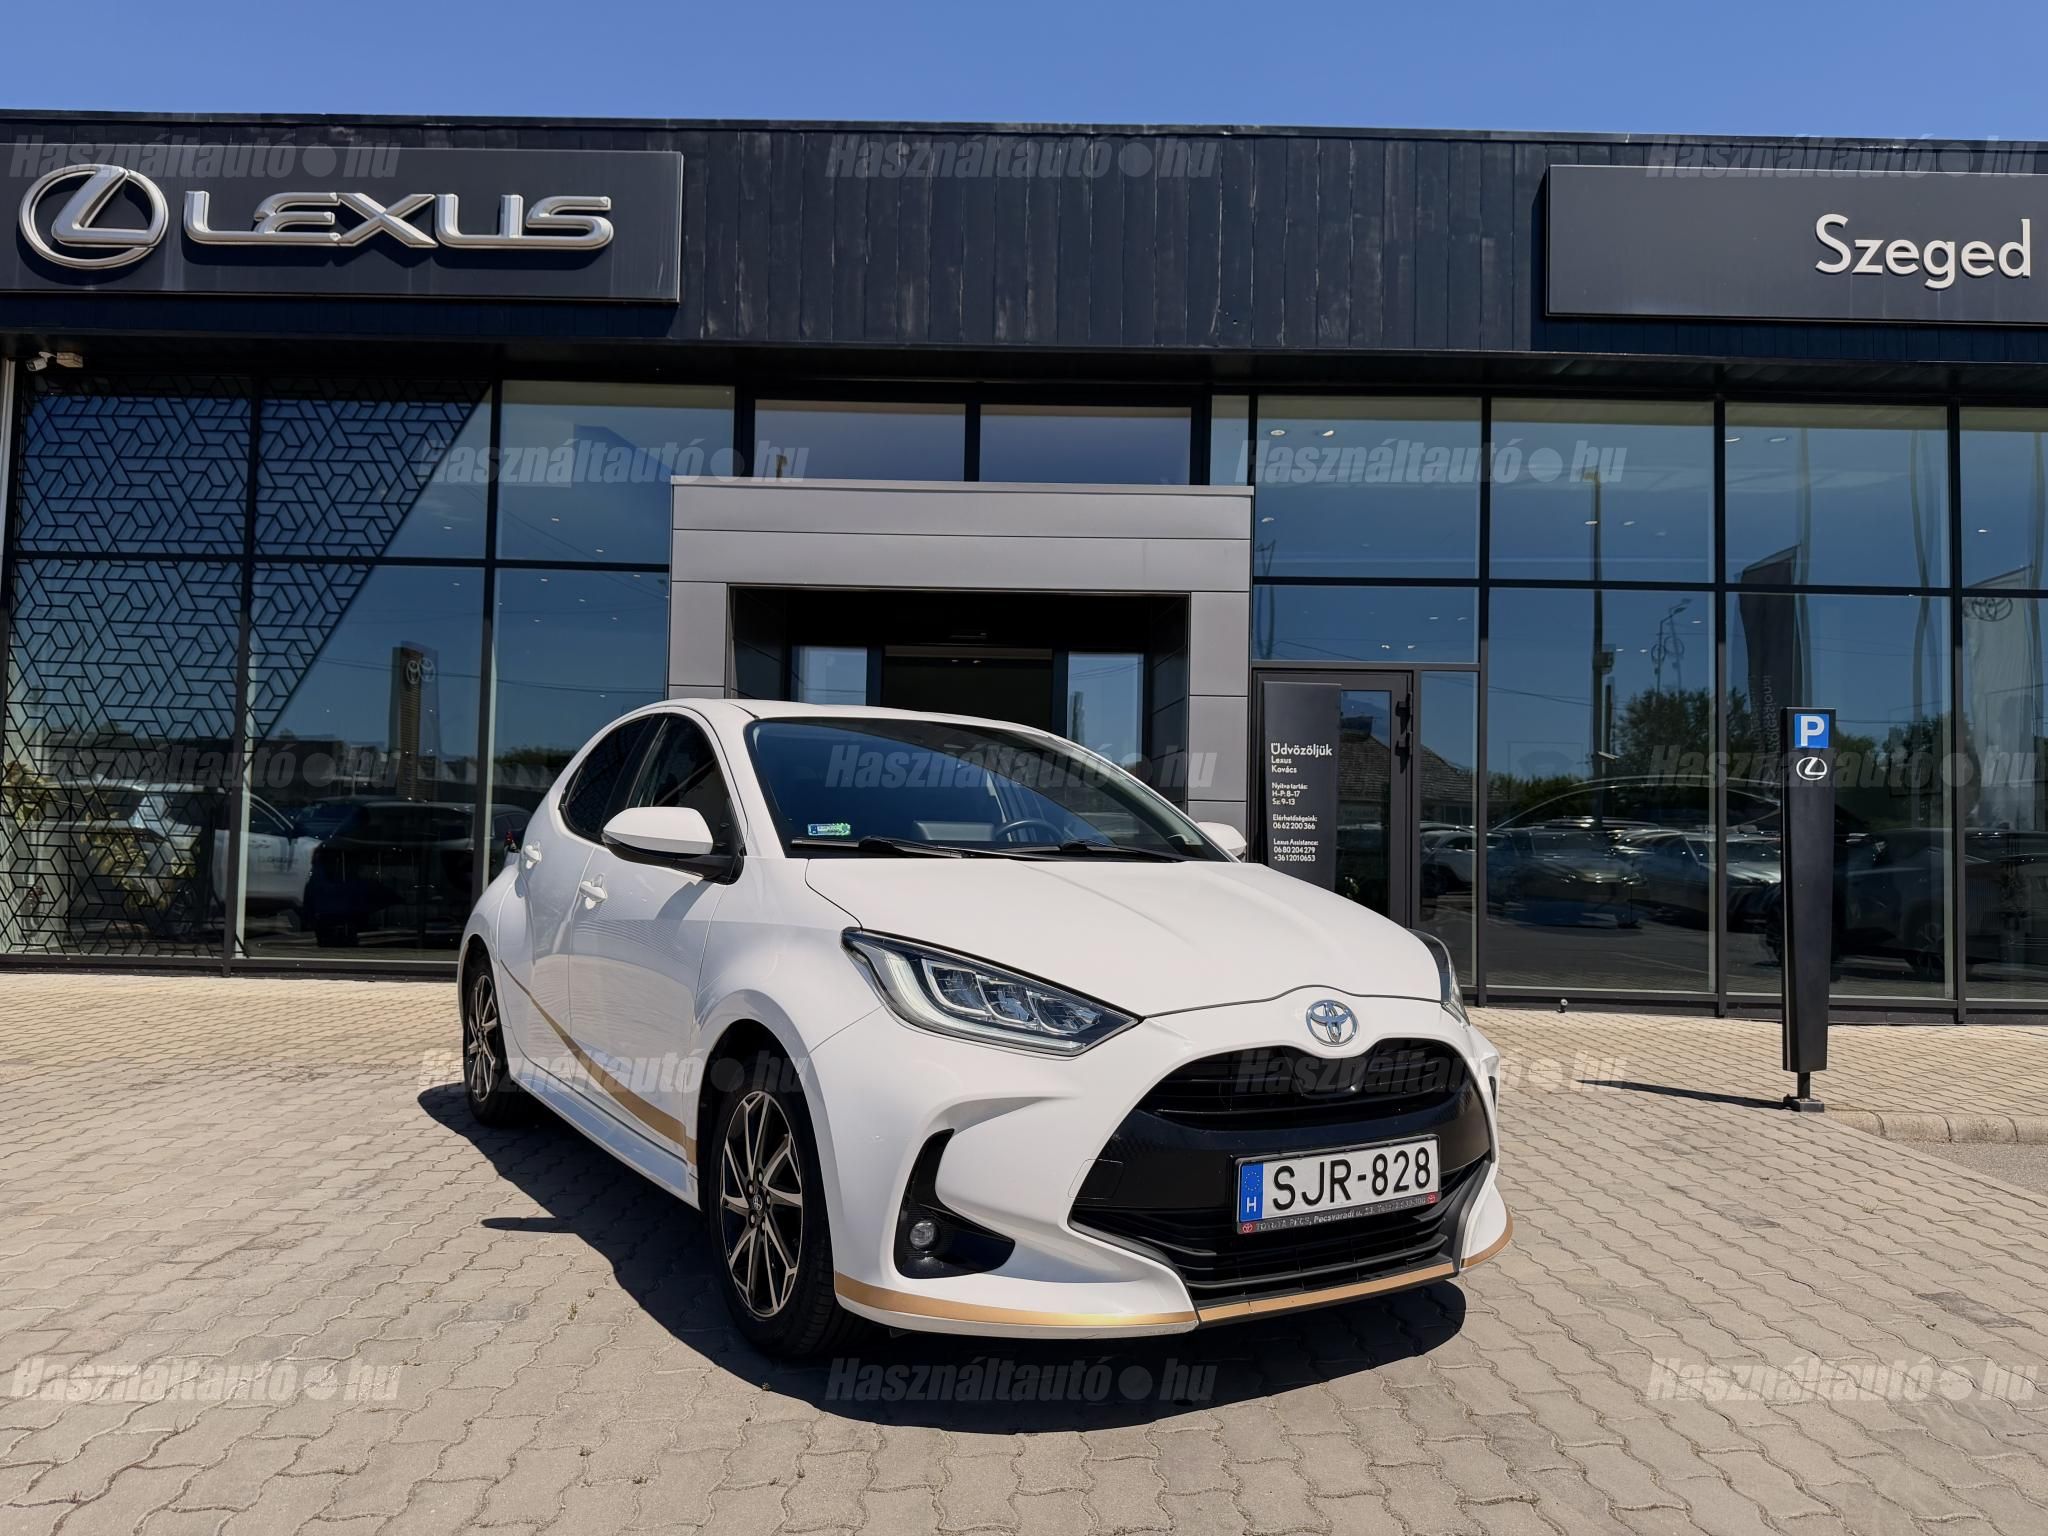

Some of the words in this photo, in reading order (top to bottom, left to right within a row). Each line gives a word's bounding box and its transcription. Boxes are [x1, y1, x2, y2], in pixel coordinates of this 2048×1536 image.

[183, 191, 615, 249] LEXUS
[1815, 213, 2032, 289] Szeged
[1801, 716, 1824, 747] P
[1271, 742, 1333, 757] Üdvözöljük
[1271, 755, 1292, 764] Lexus
[1271, 765, 1298, 773] Kovács
[1272, 1146, 1431, 1211] SJR-828
